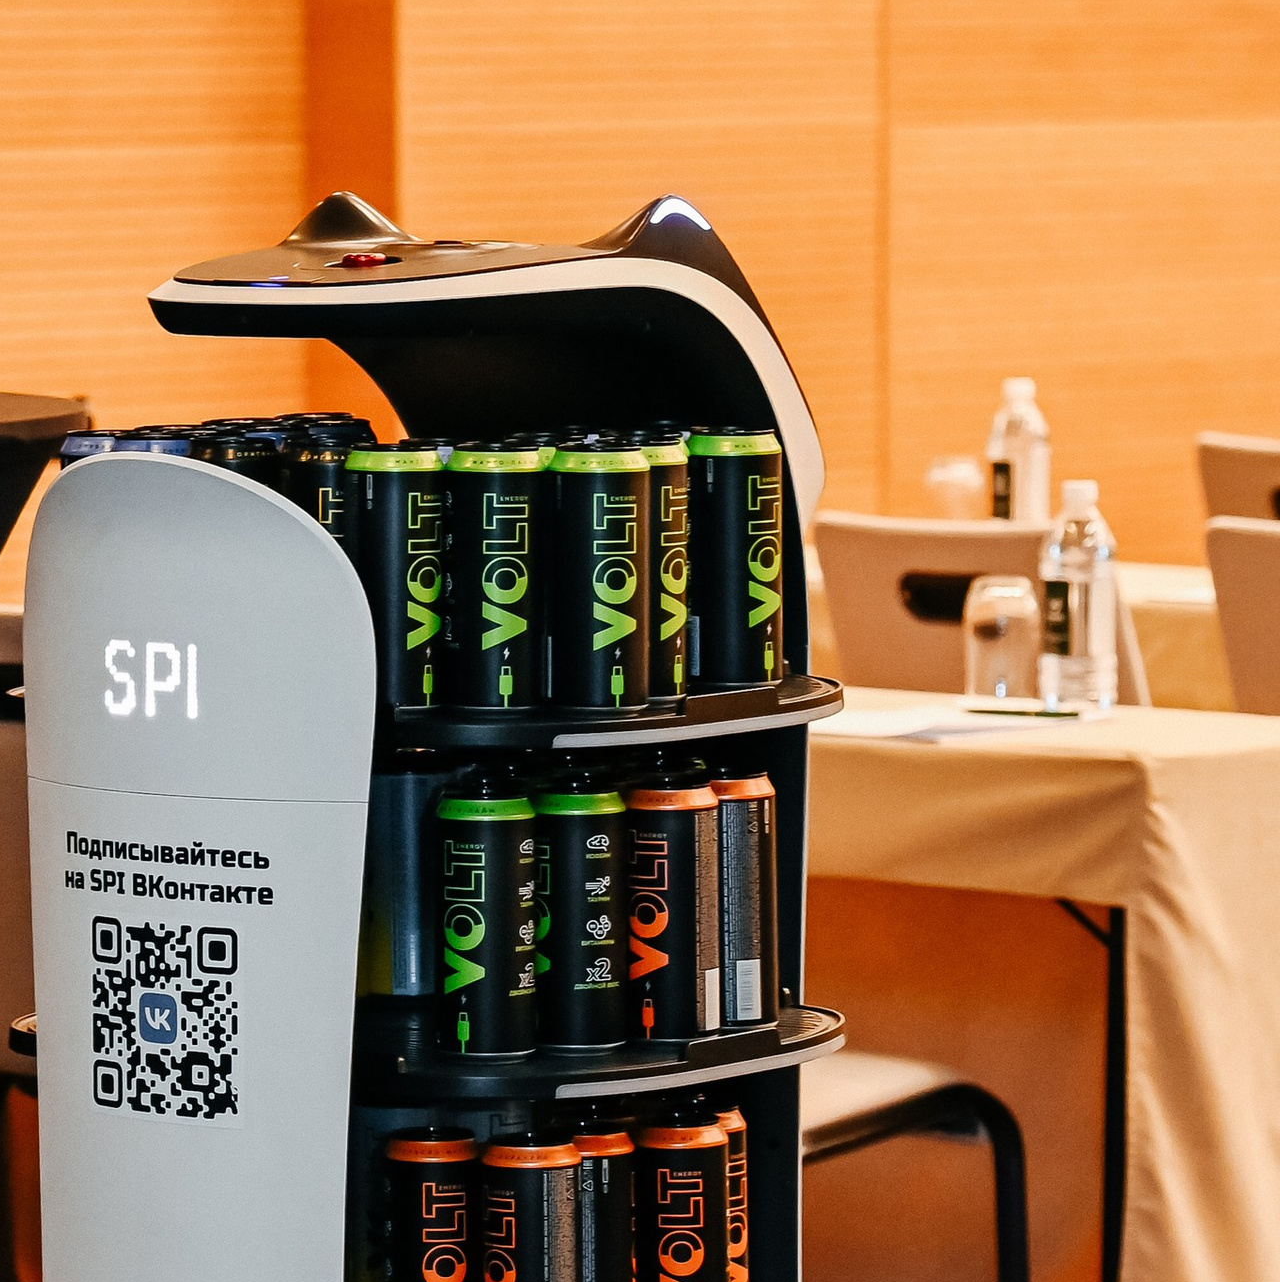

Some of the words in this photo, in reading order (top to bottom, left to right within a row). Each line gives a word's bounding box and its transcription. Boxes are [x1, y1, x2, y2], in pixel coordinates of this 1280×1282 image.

[407, 492, 442, 651] VOLT
[481, 492, 529, 651] VOLT
[592, 492, 638, 652] VOLT
[660, 485, 688, 642] VOLT
[748, 475, 782, 628] VOLT
[104, 639, 198, 719] SPI
[65, 870, 86, 890] на
[90, 868, 126, 896] SPI
[132, 872, 274, 905] ВКонтакте
[66, 830, 271, 870] Подписывайтесь
[444, 839, 486, 995] VOLT
[629, 828, 669, 981] VOLT
